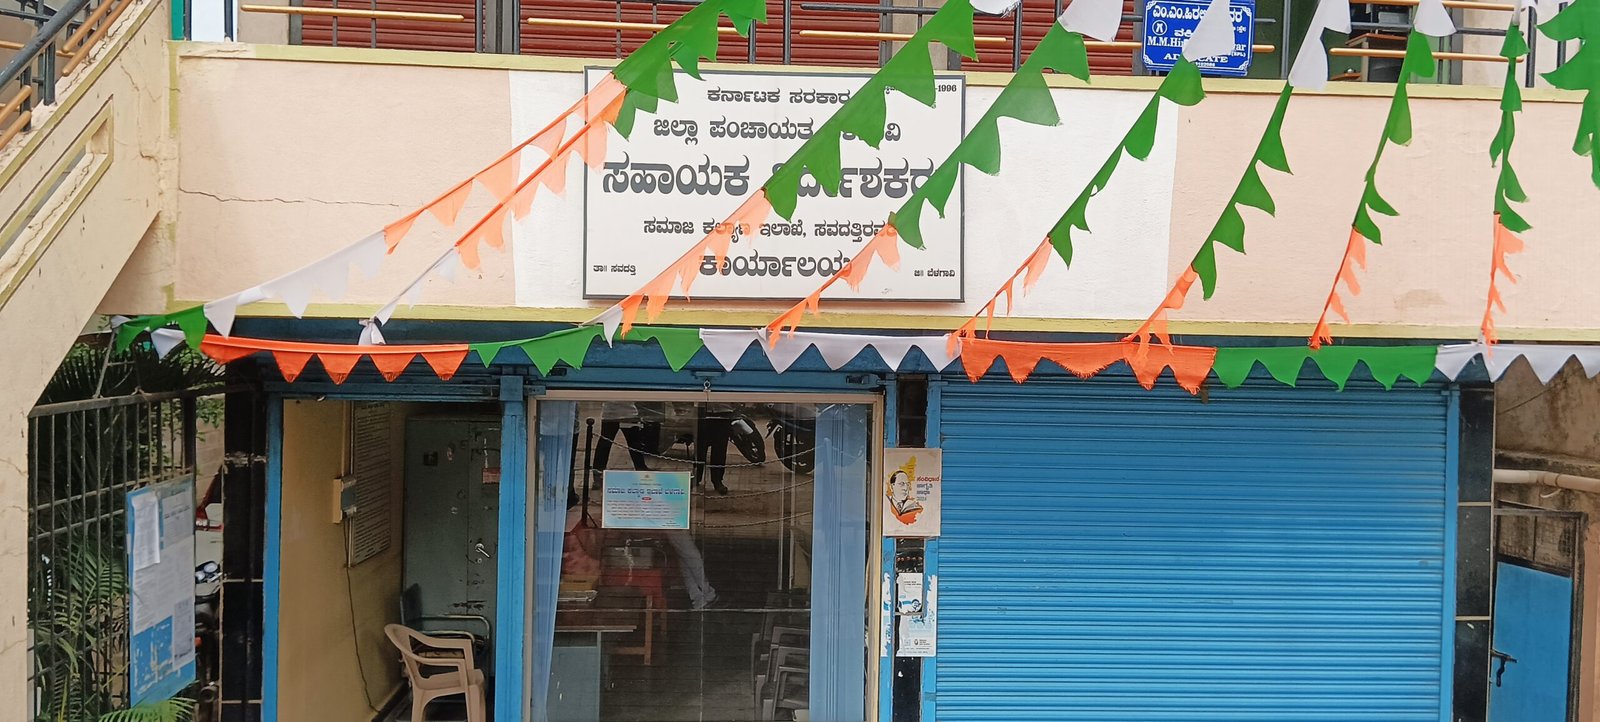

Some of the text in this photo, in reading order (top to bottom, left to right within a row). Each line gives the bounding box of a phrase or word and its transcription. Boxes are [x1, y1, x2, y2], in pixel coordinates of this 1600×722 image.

[707, 86, 780, 103] ಕರ್ನಾಟಕ
[653, 117, 699, 145] ಜಿಲ್ಲಾ
[602, 151, 750, 197] ಸಹಾಯಕ
[643, 216, 695, 235] ಸಮಾಜ
[702, 217, 751, 243] ಕಲ್ಯಾಣ
[611, 264, 636, 276] ಸವದತ್ತಿ
[699, 249, 852, 277] ಕಾರ್ಯಾಲಯ
[927, 268, 955, 277] ಬೆಳಗಾವಿ
